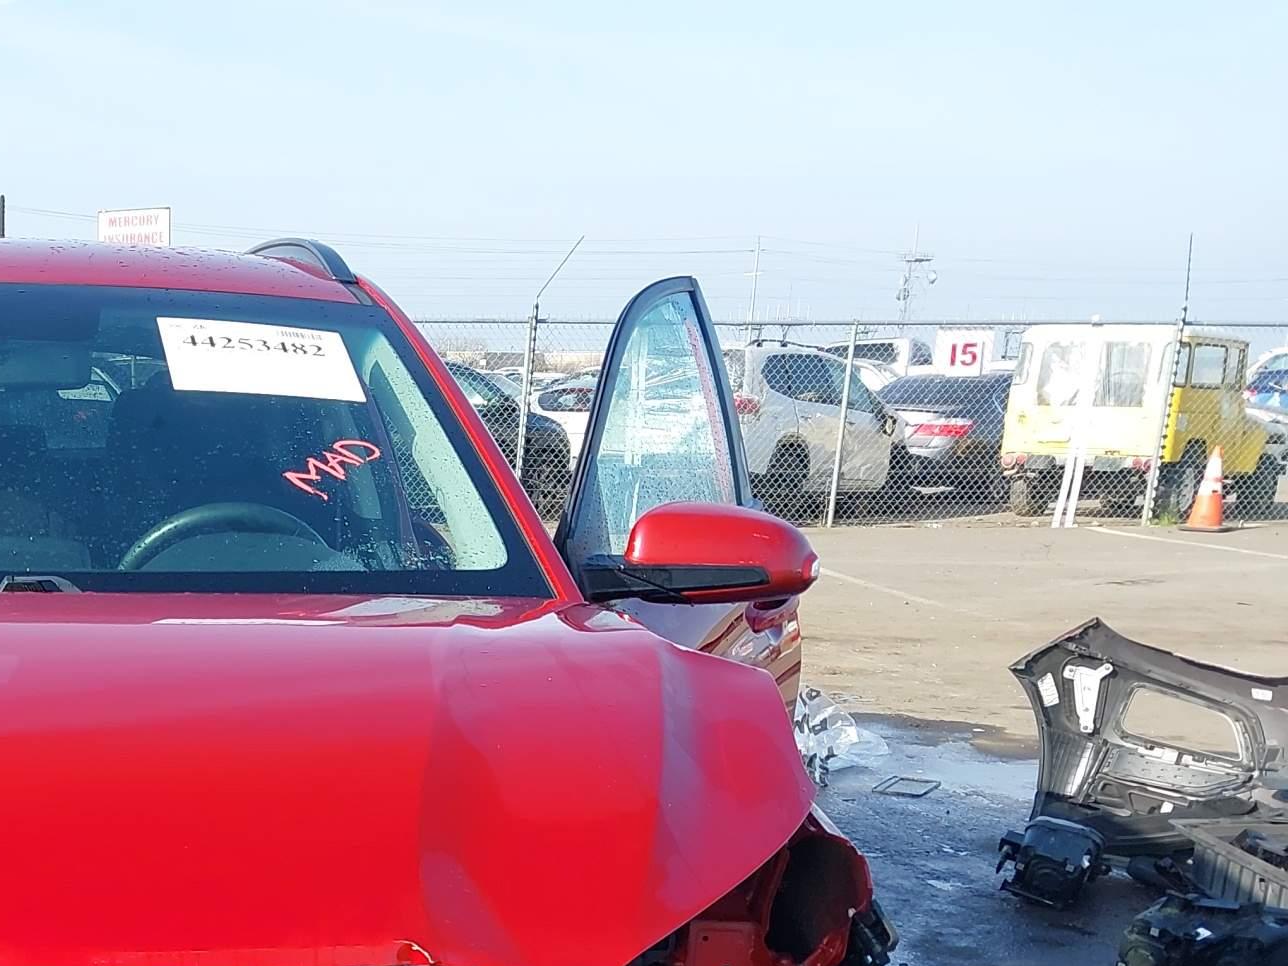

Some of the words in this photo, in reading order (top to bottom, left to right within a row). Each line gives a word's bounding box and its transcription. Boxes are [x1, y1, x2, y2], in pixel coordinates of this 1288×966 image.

[107, 214, 160, 228] MERCURY
[182, 334, 326, 357] 44253482
[950, 342, 978, 367] 15
[281, 439, 381, 500] MAD
